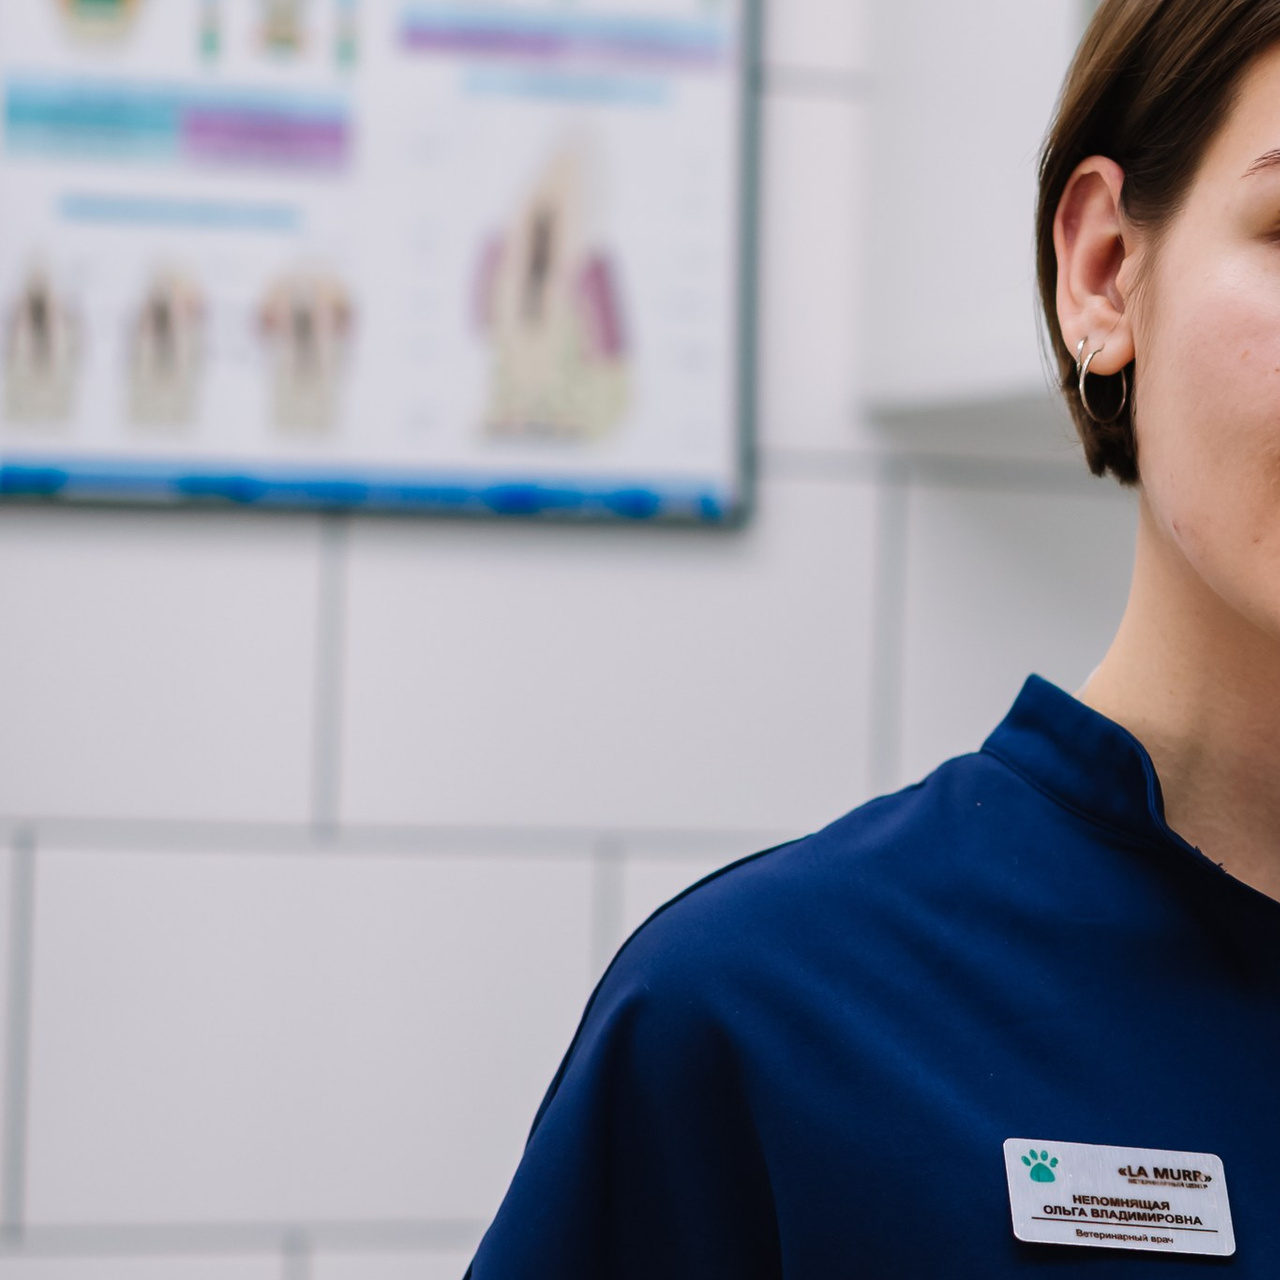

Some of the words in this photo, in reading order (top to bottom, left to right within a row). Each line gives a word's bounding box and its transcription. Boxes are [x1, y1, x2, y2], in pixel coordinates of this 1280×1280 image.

[1072, 1194, 1171, 1211] НЕПОМНЯЩАЯ
[1043, 1205, 1088, 1218] ОЛЬГА
[1091, 1208, 1203, 1226] ВЛАДИМИРОВНА
[1076, 1228, 1149, 1242] Ветеринарный
[1151, 1235, 1174, 1244] врач
